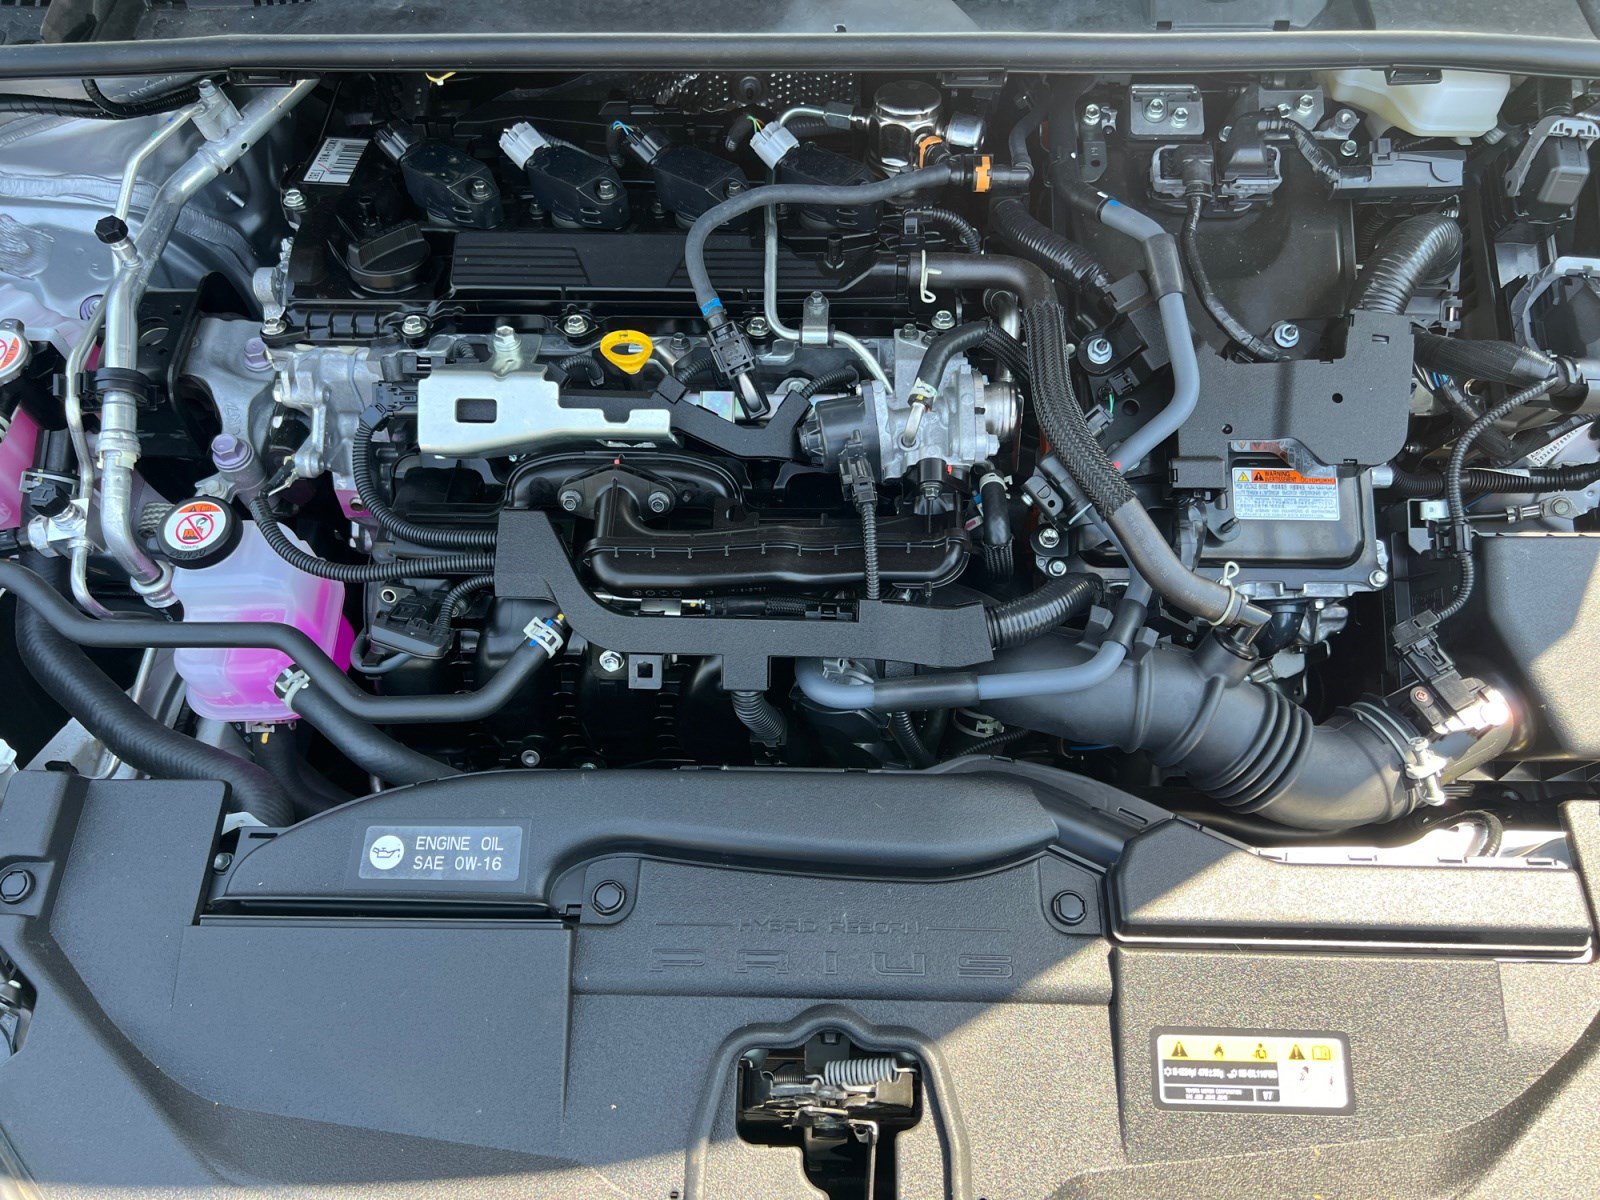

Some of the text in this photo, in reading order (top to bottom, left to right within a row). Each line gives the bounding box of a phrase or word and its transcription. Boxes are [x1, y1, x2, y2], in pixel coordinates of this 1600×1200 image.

[415, 836, 504, 851] ENGINE OIL
[413, 855, 502, 871] SAE 0W-16
[738, 920, 921, 934] HYBRID REBORN
[650, 949, 1013, 978] PRIUS
